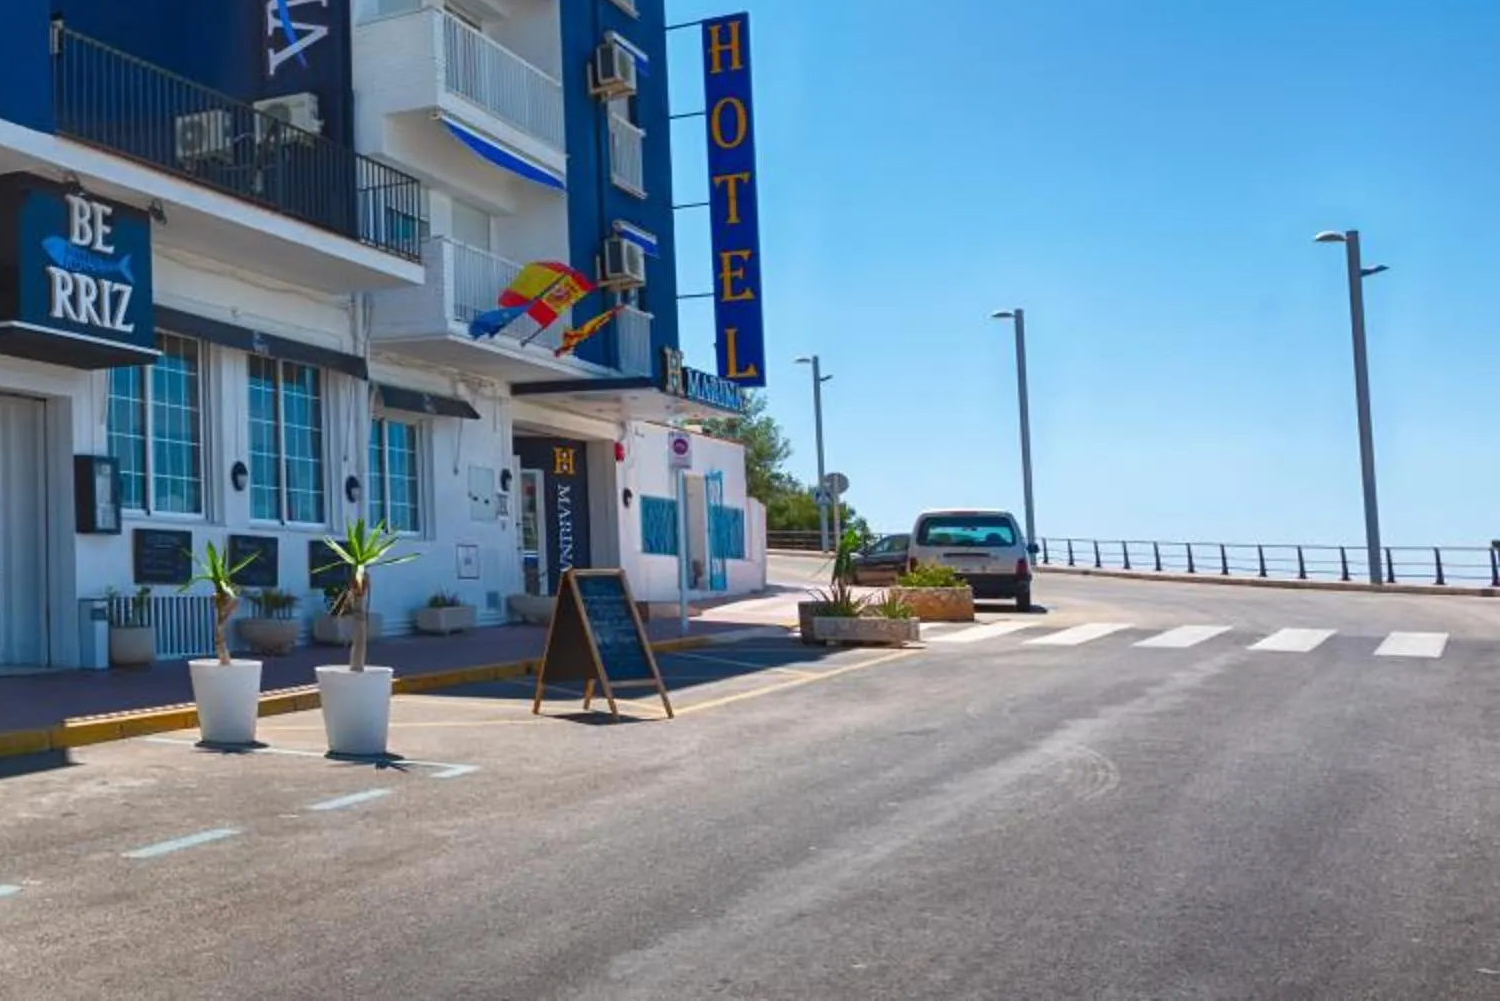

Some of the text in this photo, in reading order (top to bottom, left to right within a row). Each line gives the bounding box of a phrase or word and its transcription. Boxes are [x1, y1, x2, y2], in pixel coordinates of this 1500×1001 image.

[64, 193, 115, 255] BE
[707, 20, 757, 379] HOTEL
[46, 265, 135, 333] RRIZ
[686, 368, 744, 412] MARINA
[553, 446, 576, 475] H
[557, 483, 573, 573] MARINA
